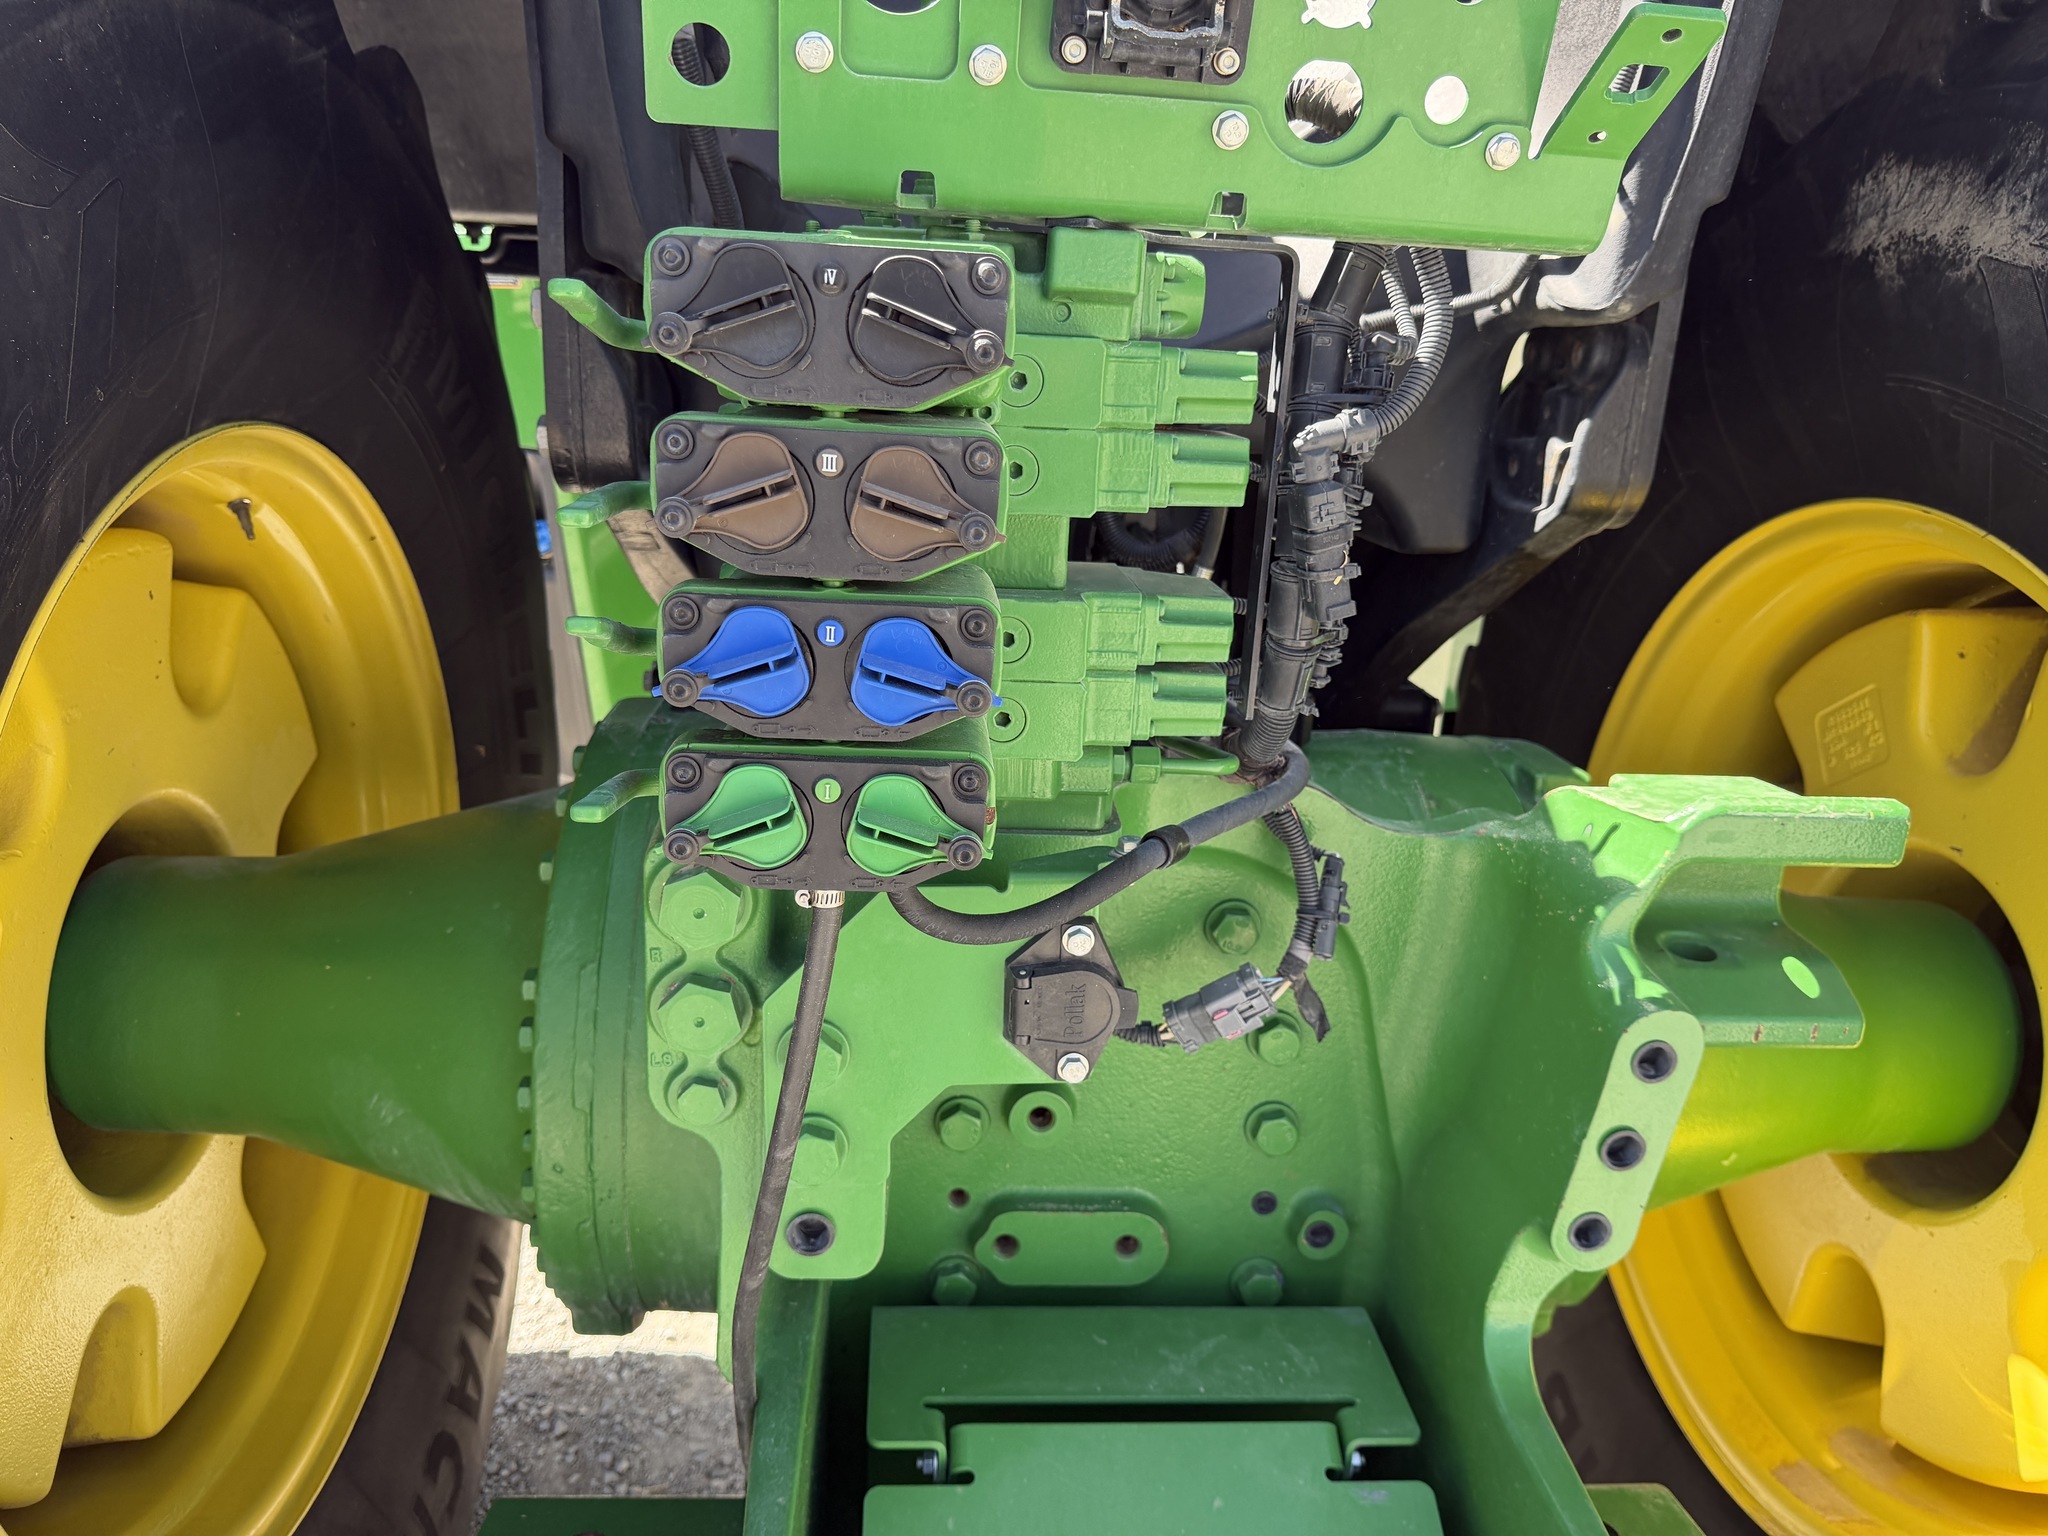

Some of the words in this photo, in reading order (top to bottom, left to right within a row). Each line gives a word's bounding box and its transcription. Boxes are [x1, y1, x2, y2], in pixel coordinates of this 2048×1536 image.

[821, 453, 838, 473] III
[825, 625, 836, 643] II
[824, 784, 831, 800] I
[1063, 982, 1087, 1039] Pollak
